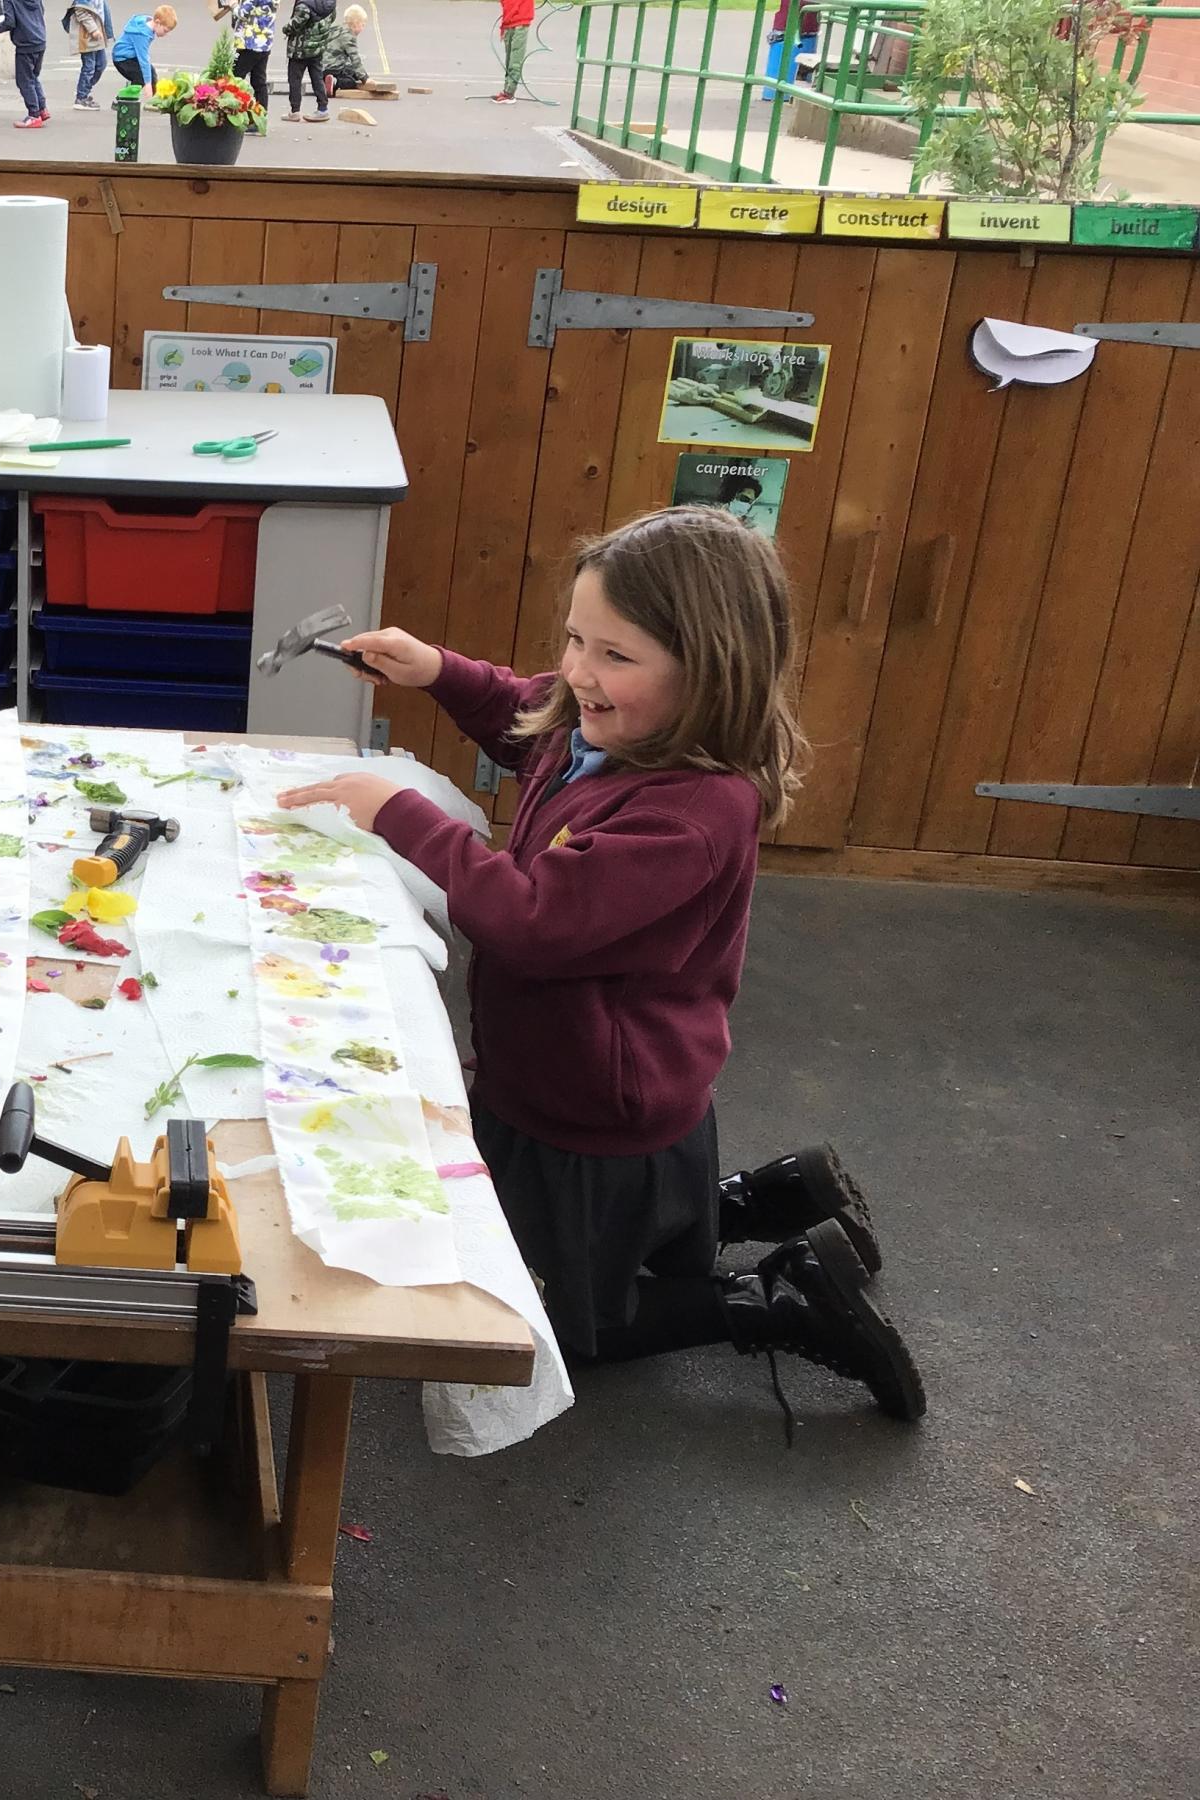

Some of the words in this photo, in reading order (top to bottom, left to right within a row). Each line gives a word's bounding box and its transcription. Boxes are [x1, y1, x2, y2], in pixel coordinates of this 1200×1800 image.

[606, 195, 668, 218] design
[729, 204, 789, 221] create
[837, 211, 928, 227] construct
[979, 211, 1040, 230] invent
[1110, 218, 1160, 236] build
[191, 347, 214, 356] Look
[215, 348, 240, 357] What
[243, 349, 248, 358] I
[250, 349, 268, 359] Can
[271, 351, 287, 360] Do!
[694, 345, 767, 366] Workshop
[772, 350, 806, 366] Area
[696, 462, 769, 478] carpenter
